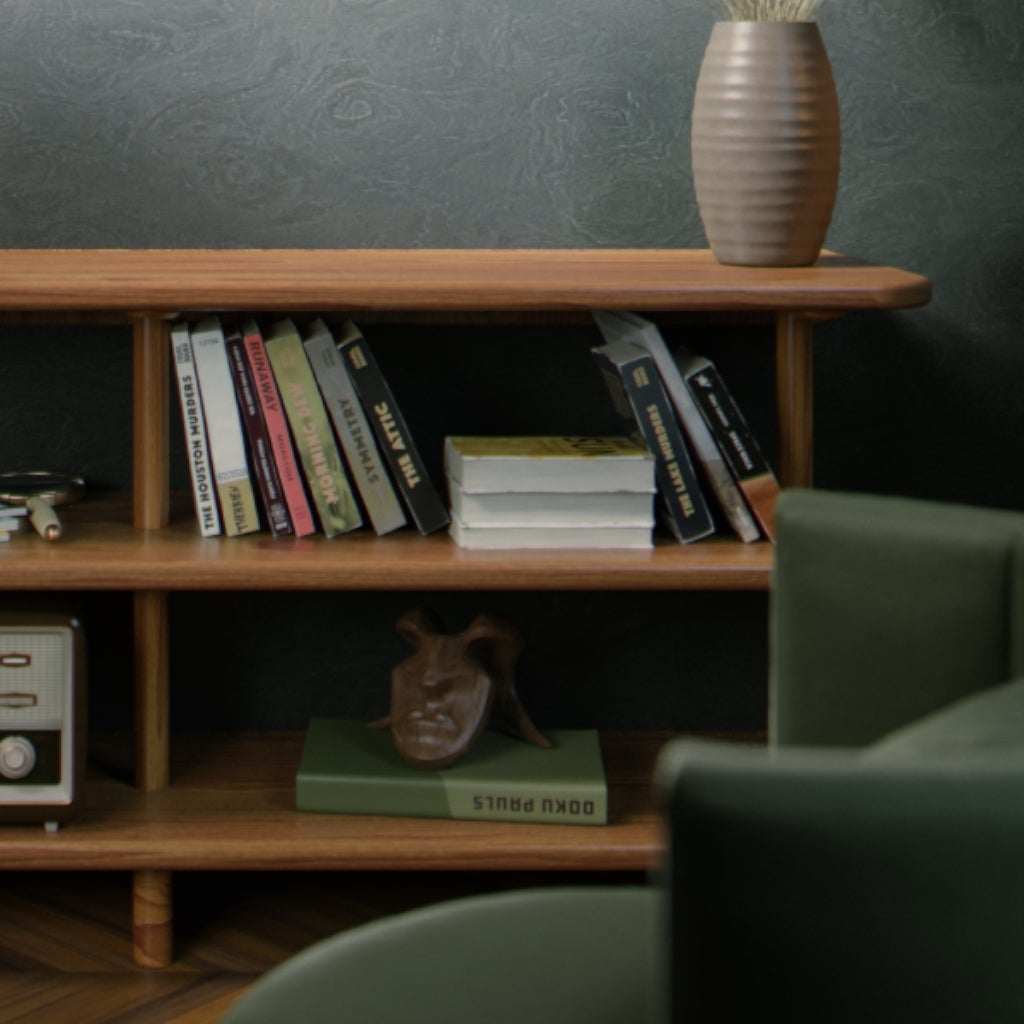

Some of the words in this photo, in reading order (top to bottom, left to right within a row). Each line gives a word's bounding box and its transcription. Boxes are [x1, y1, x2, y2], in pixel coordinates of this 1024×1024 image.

[182, 375, 201, 436] MURDERS
[249, 342, 279, 412] RUNAWAY
[338, 399, 380, 484] SYMMETRY
[374, 401, 406, 450] ATTIC
[192, 440, 210, 503] HOUSTON
[302, 422, 340, 505] MORNING
[397, 453, 422, 489] THE
[202, 507, 215, 530] THE
[472, 795, 535, 813] PAULS
